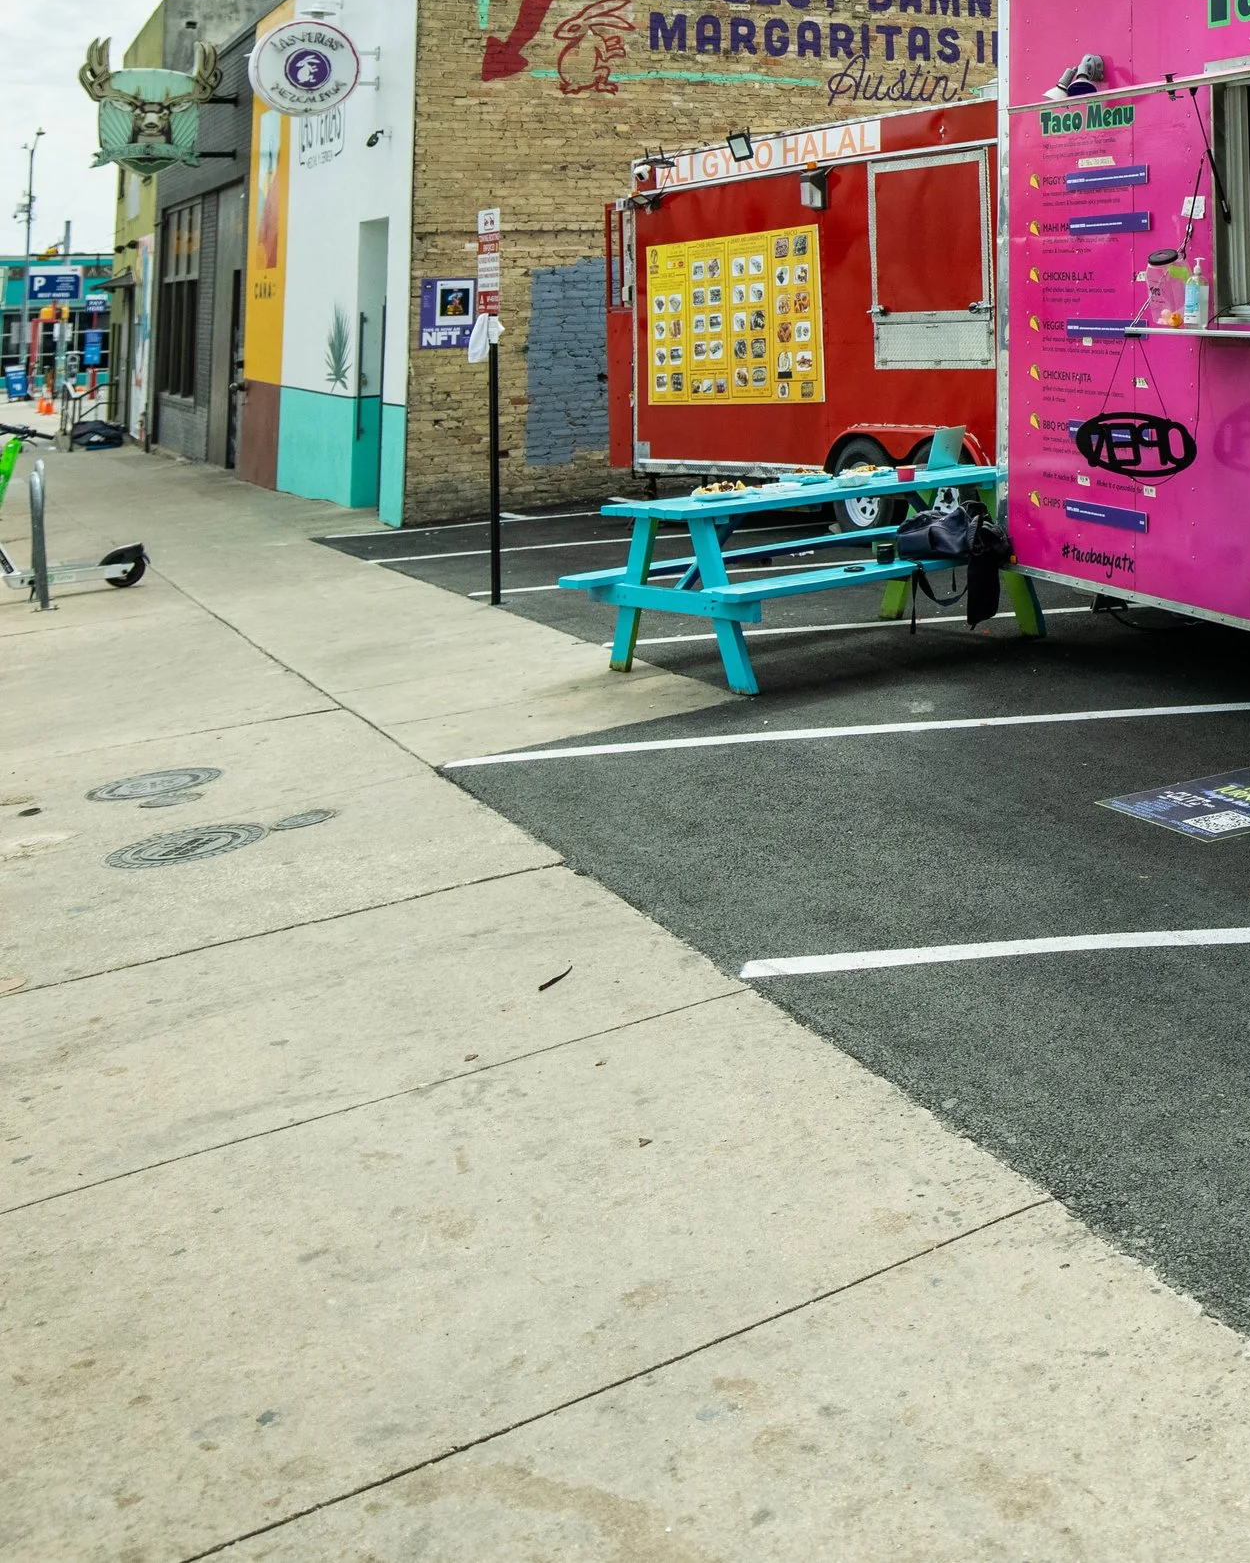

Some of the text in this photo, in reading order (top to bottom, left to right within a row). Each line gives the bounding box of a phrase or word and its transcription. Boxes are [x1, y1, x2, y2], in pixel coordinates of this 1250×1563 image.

[649, 11, 998, 67] MARGARITAS I
[827, 53, 970, 106] Austin!
[1040, 102, 1135, 136] Taco Menu
[781, 124, 876, 166] HALAL
[1042, 271, 1071, 281] CHICKEN
[33, 277, 46, 291] P
[1042, 321, 1064, 330] VEGGIE
[422, 331, 461, 346] NFT
[1042, 370, 1092, 384] CHICKEN FAJITA
[1043, 497, 1061, 508] CHIPS
[1062, 541, 1135, 579] #tacobabyatx
